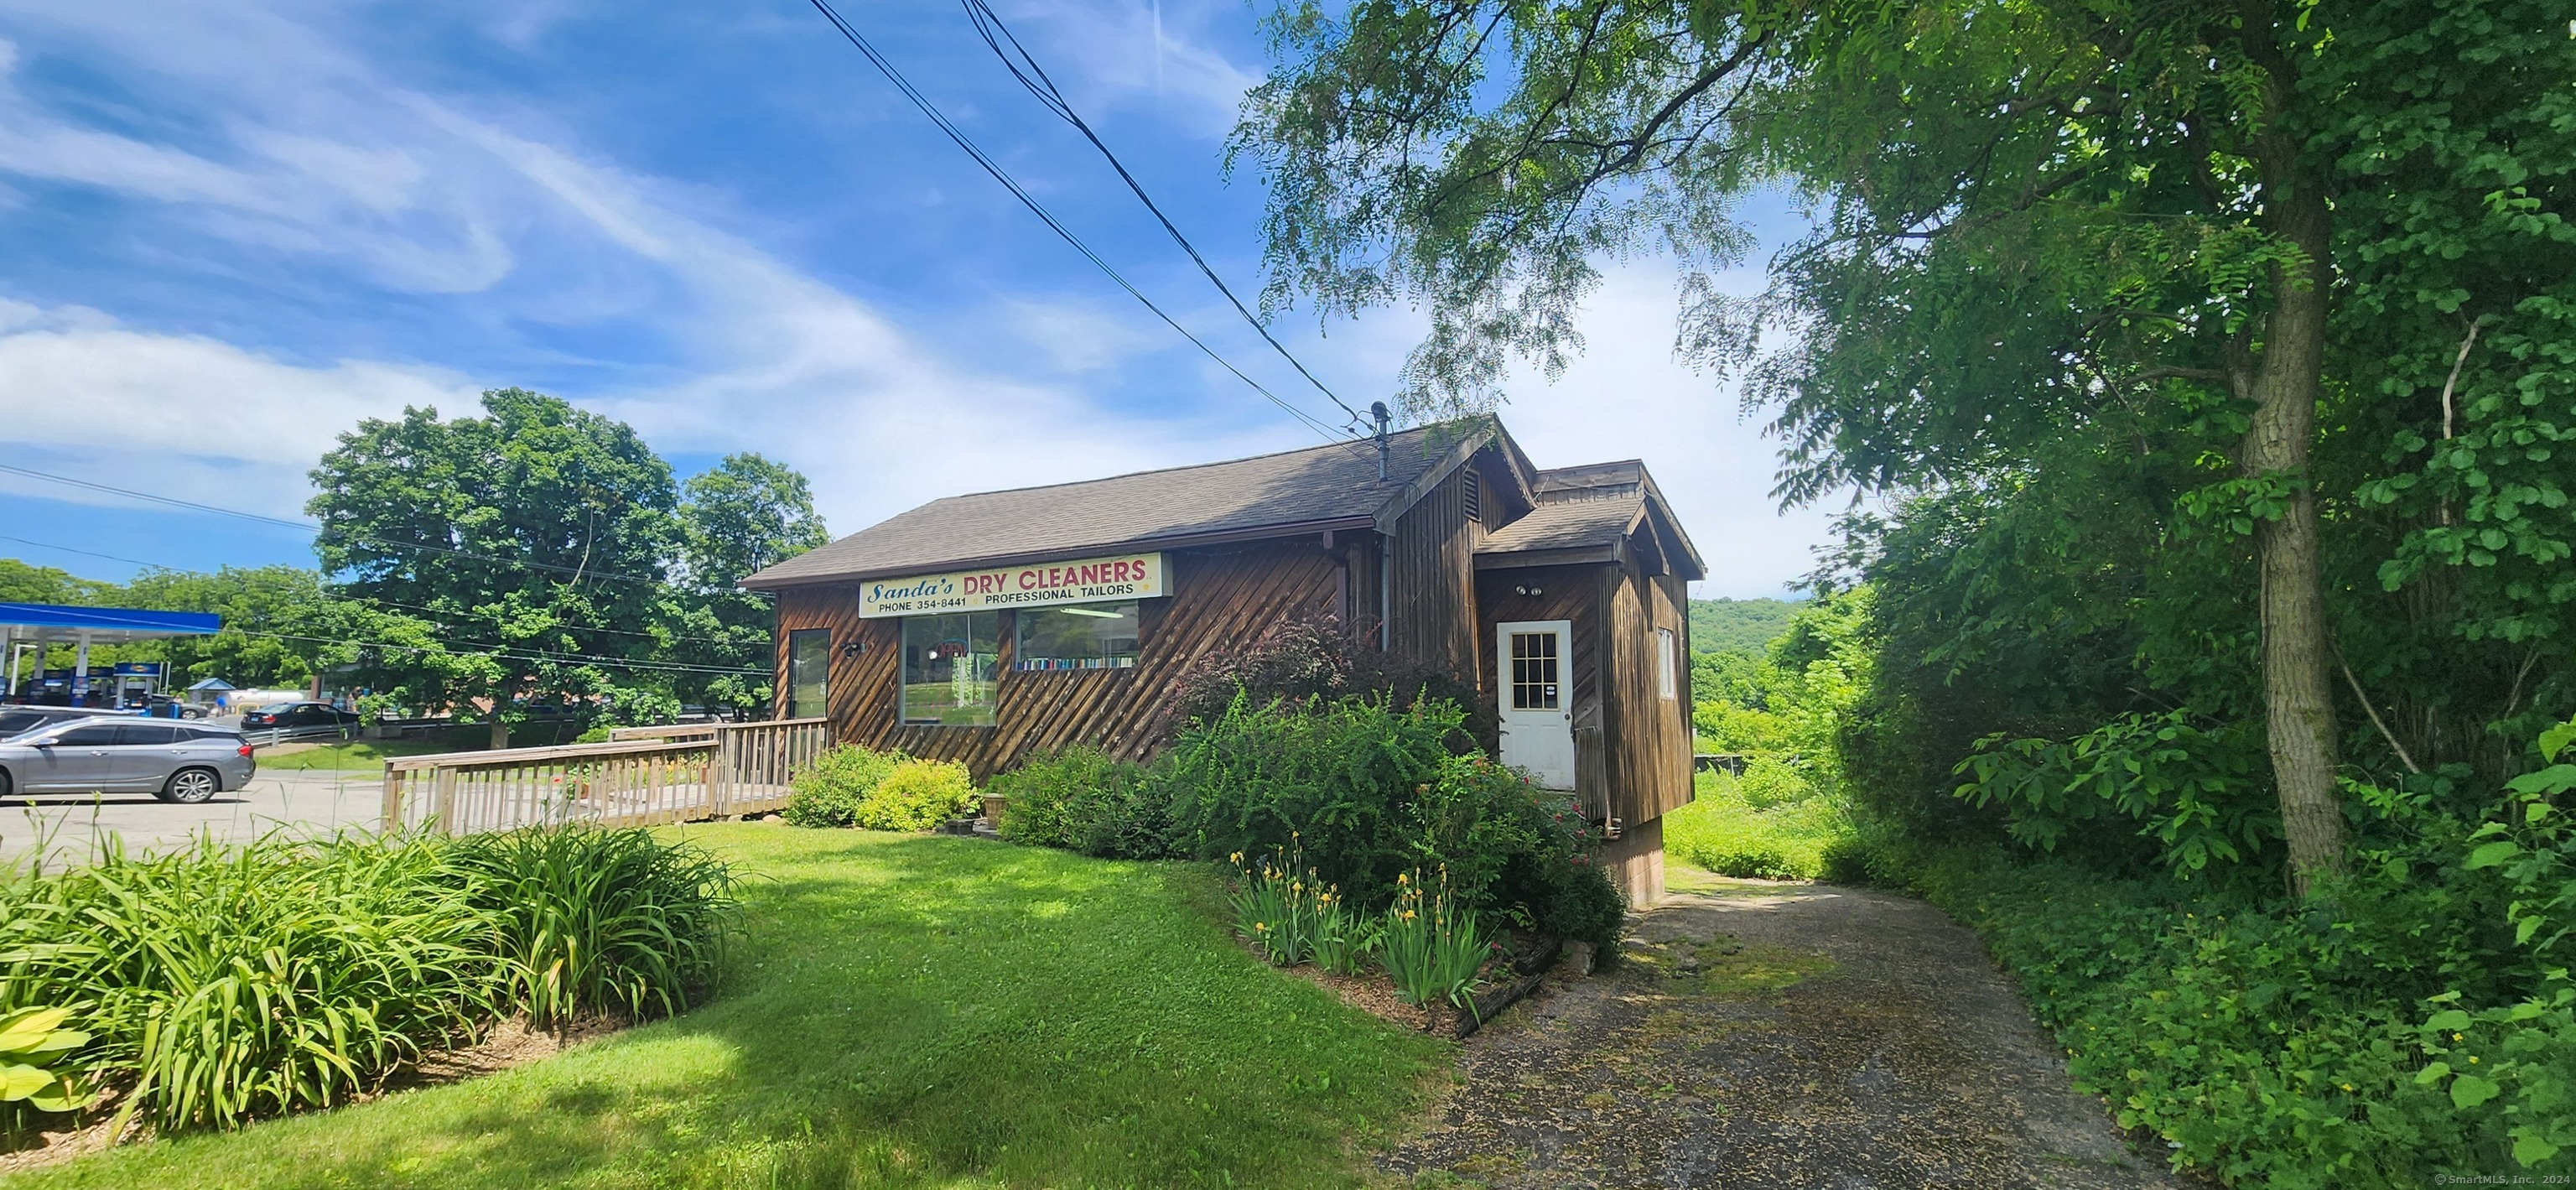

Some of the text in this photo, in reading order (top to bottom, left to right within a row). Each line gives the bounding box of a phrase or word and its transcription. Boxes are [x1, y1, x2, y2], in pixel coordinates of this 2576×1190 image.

[867, 559, 1146, 603] Sanda's DRY CLEANERS
[879, 584, 1134, 612] PHONE 354-8441 PROFESSIONAL TAILORS
[936, 642, 967, 658] OPEN
